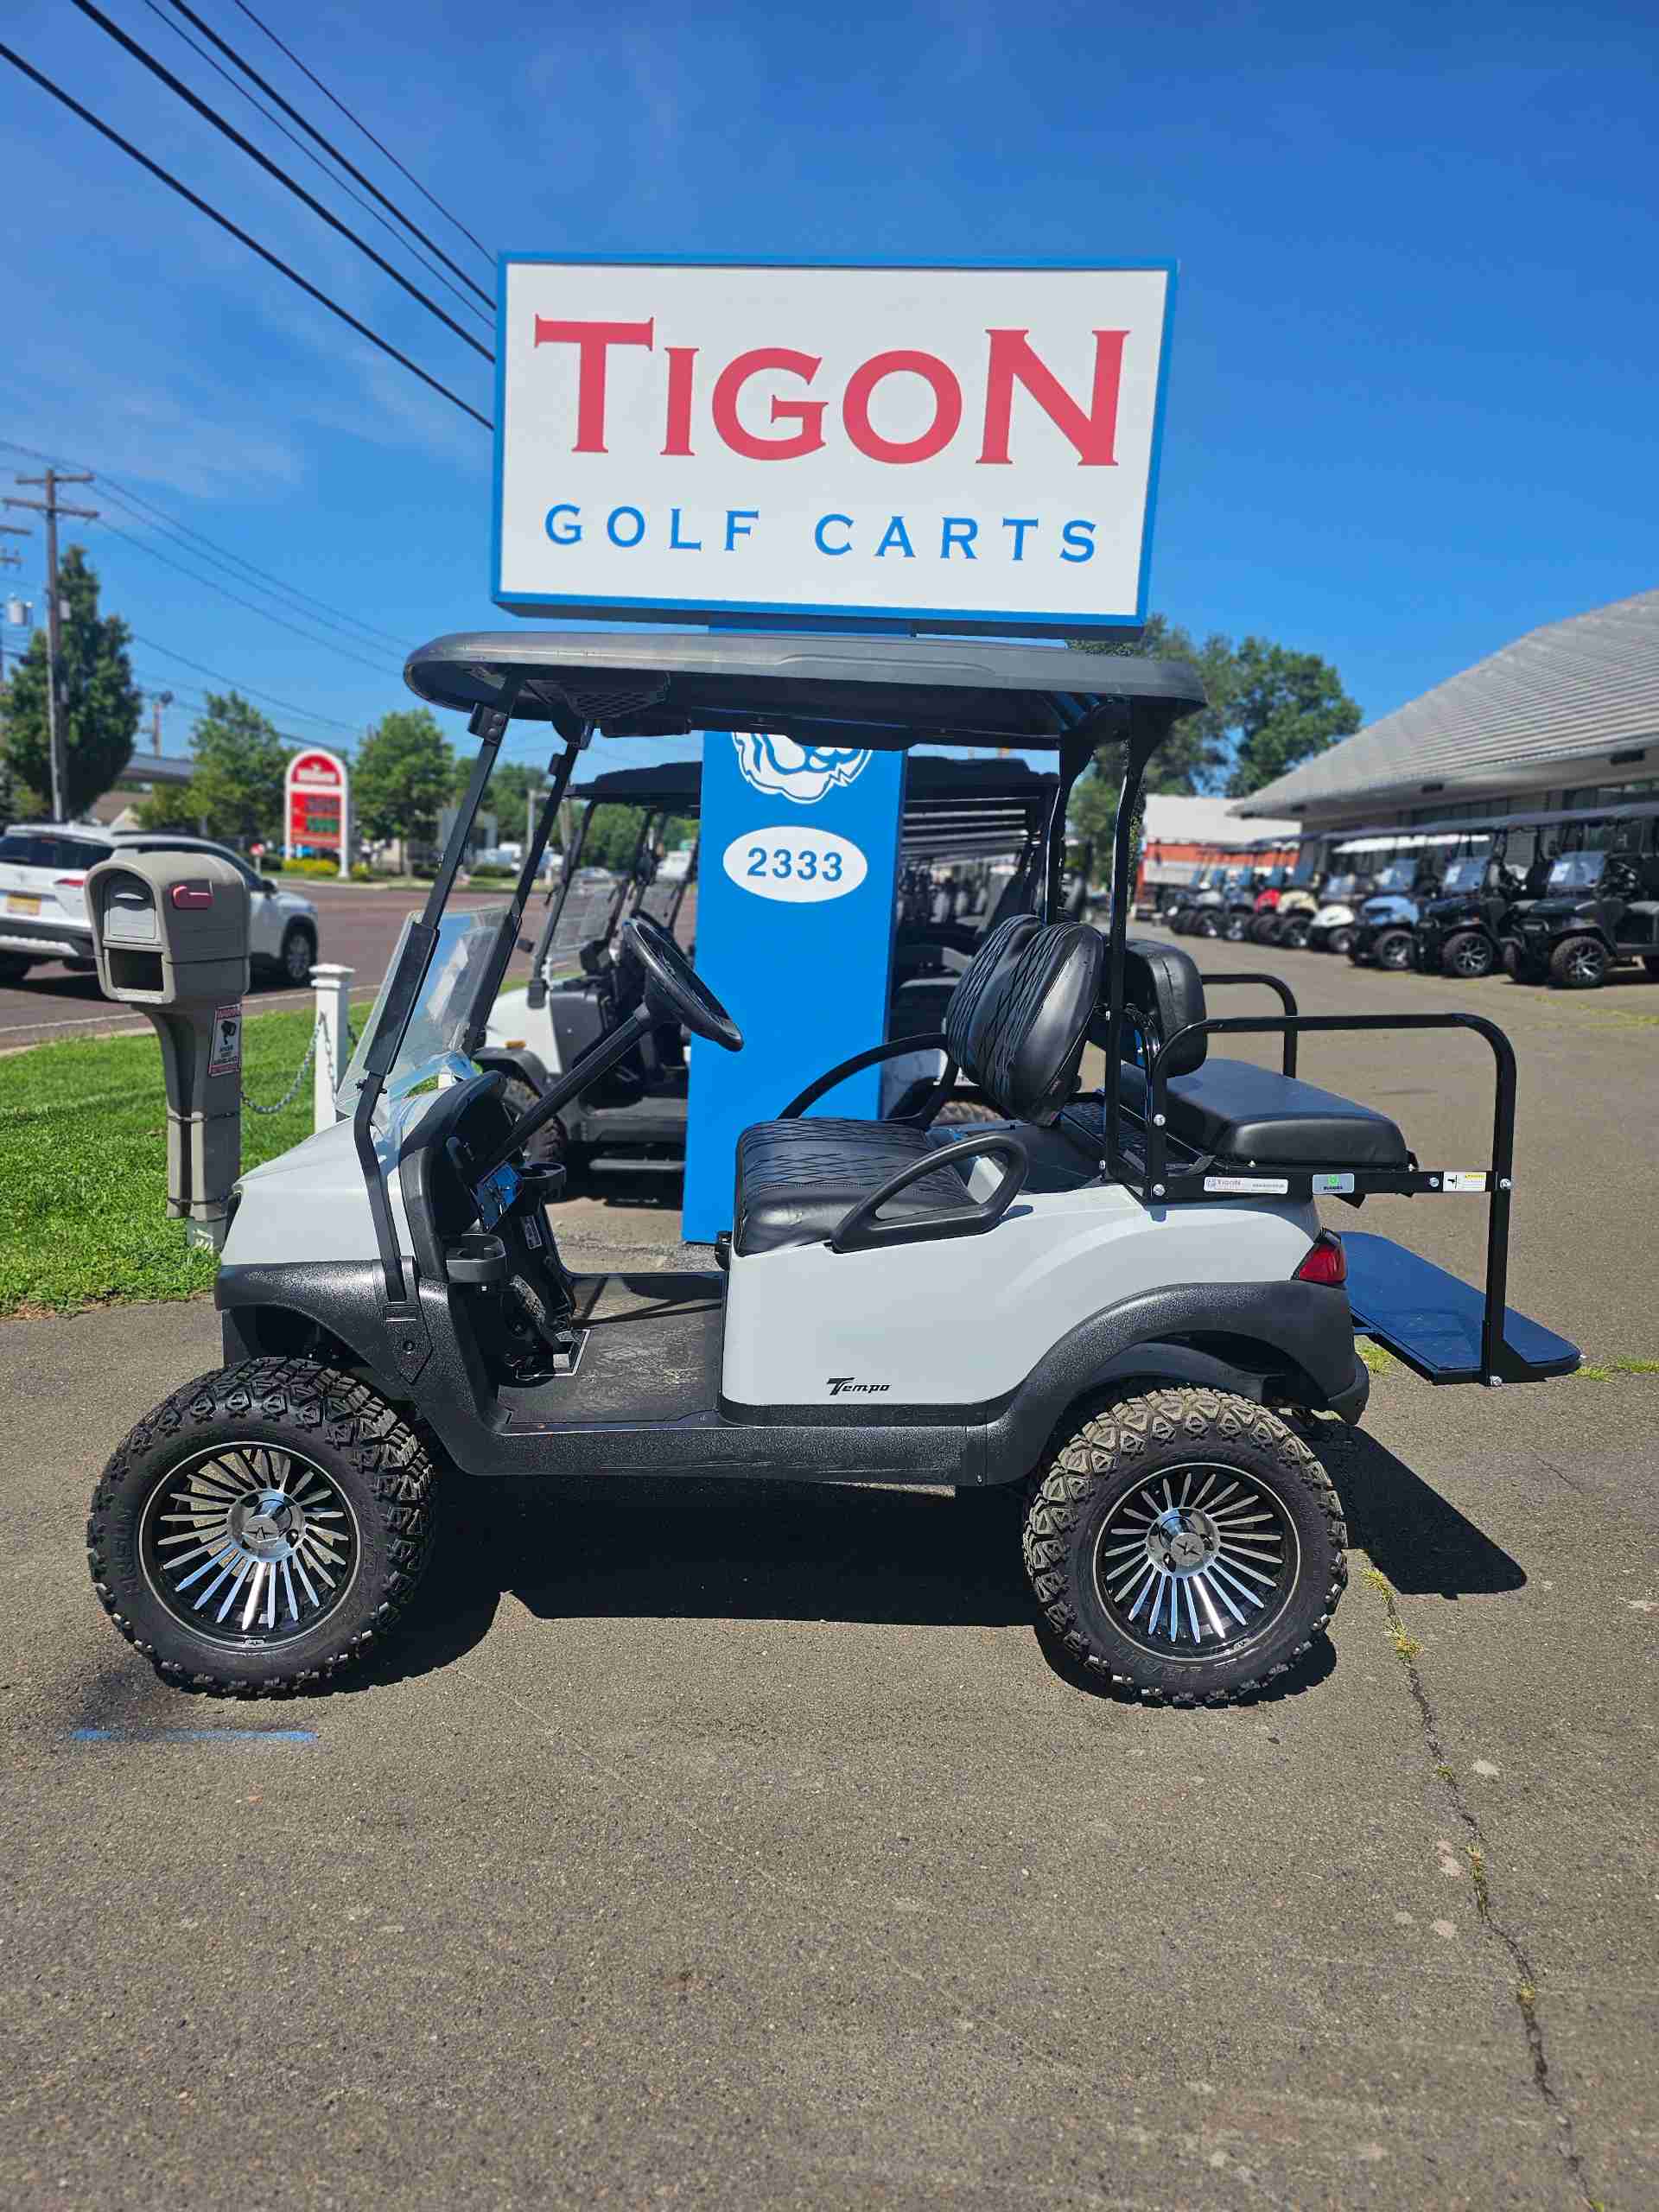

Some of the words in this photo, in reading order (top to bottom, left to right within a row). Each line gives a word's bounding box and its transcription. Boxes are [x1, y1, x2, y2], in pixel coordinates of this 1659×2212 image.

[534, 314, 1130, 467] TIGON
[544, 503, 760, 551] GOLF
[814, 513, 1096, 563] CARTS
[747, 847, 843, 882] 2333
[826, 1376, 891, 1396] Tempo
